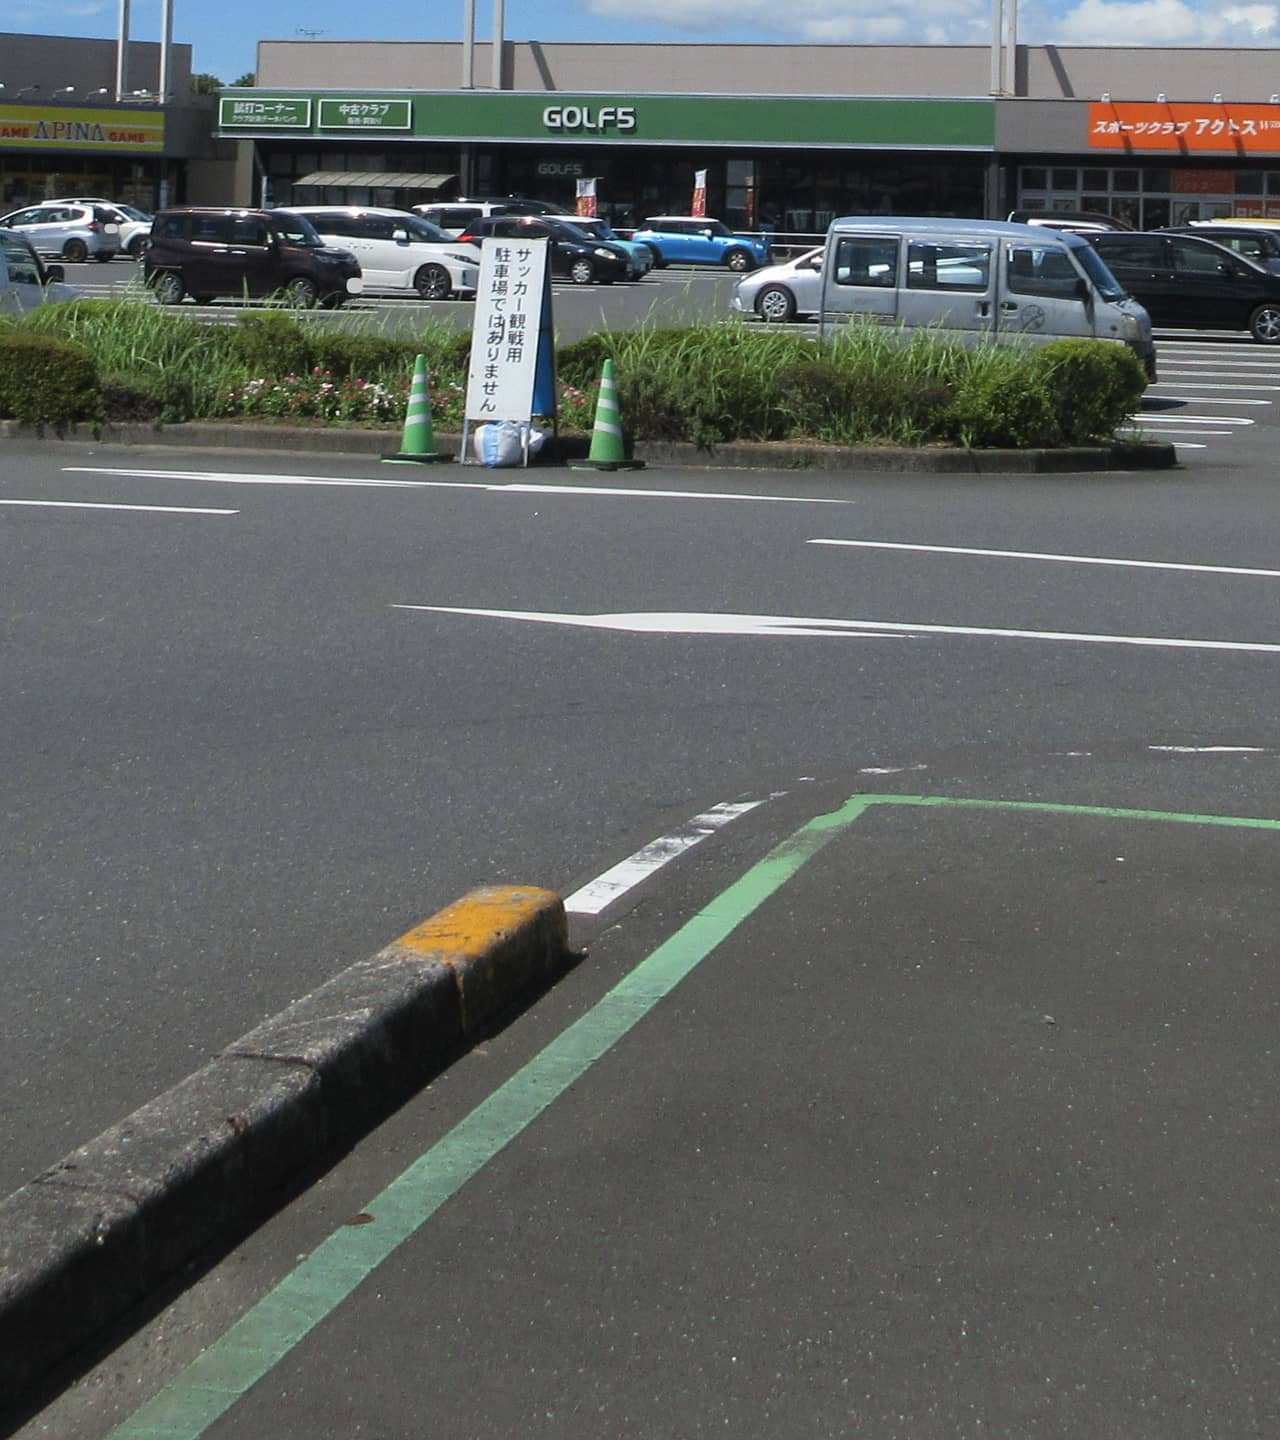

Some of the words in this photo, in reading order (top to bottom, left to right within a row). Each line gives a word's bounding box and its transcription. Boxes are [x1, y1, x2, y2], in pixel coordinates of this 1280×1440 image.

[339, 103, 391, 116] 中古クラブ
[542, 105, 636, 130] GOLF5
[34, 120, 106, 142] APINA
[109, 131, 145, 143] GAME
[1093, 120, 1190, 135] スポーツクラブ
[1194, 118, 1258, 136] アクトス
[538, 163, 583, 175] GOLF5
[506, 247, 533, 363] サッカー観戦用
[479, 247, 512, 413] 駐車場ではありません
